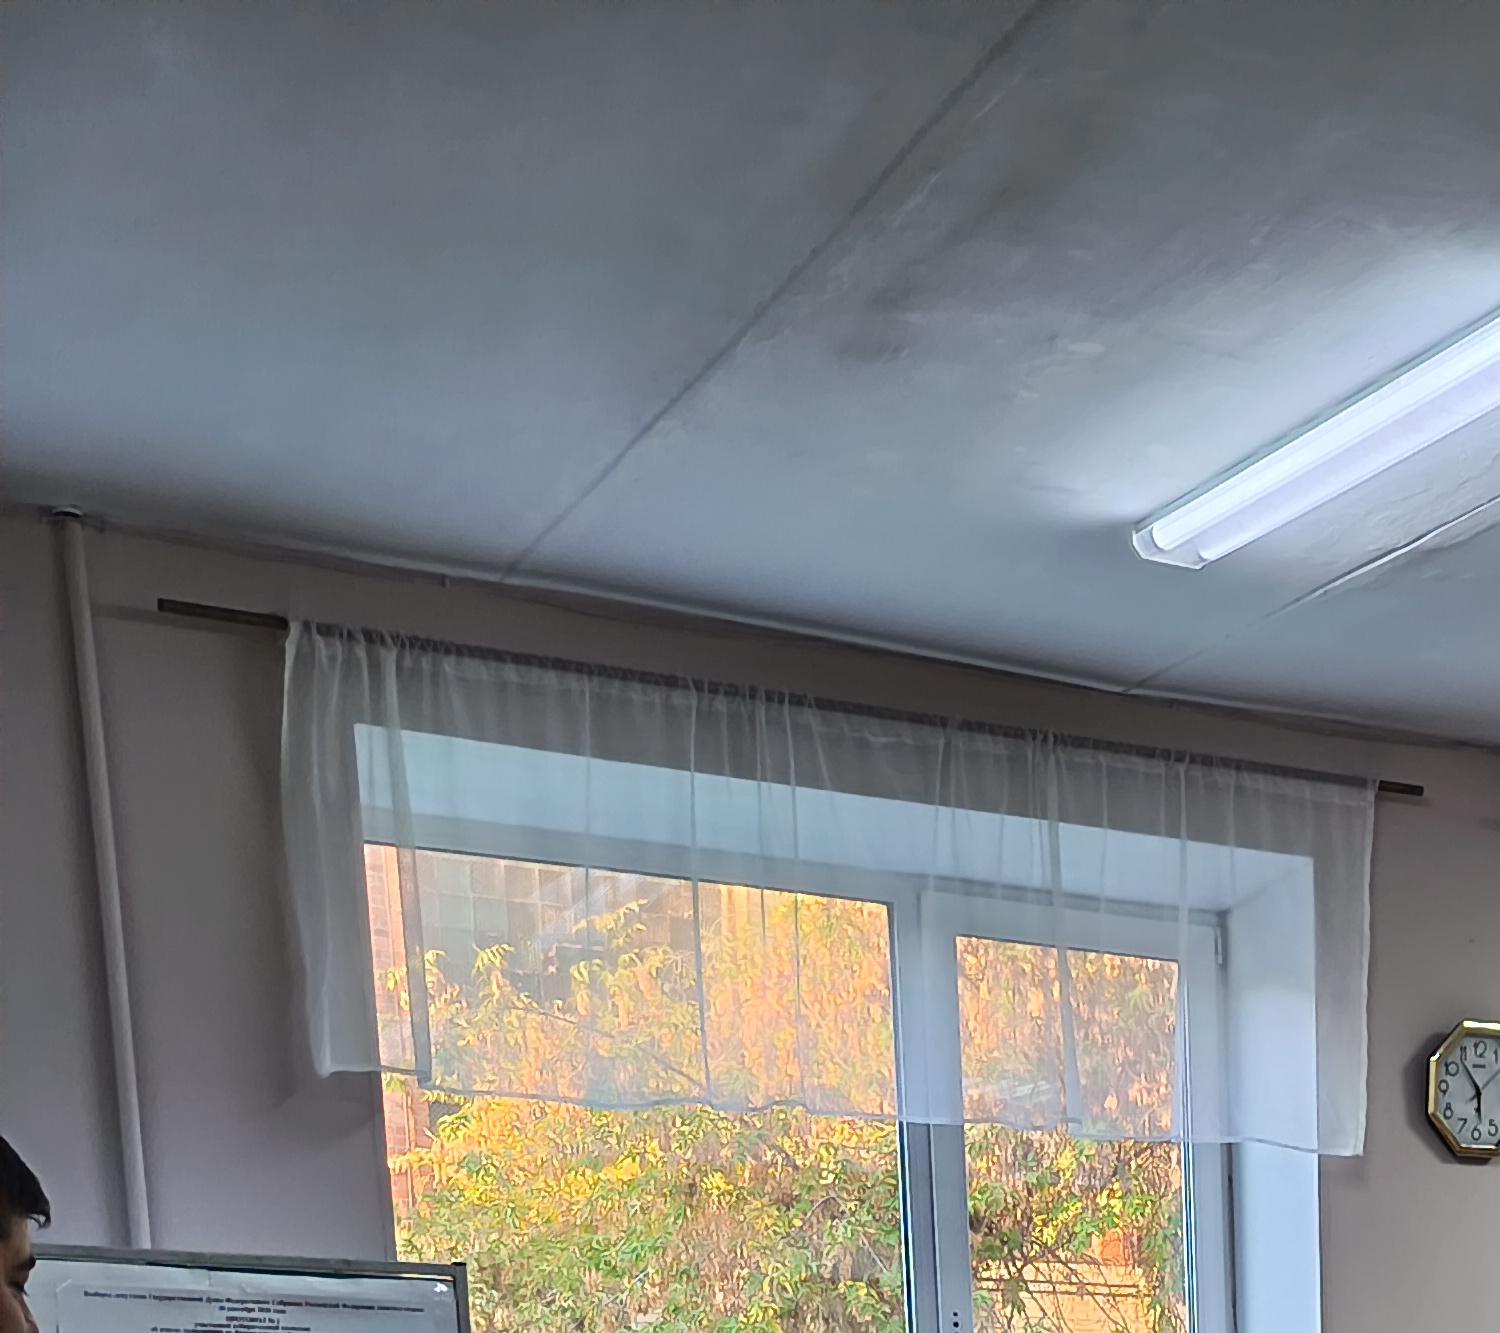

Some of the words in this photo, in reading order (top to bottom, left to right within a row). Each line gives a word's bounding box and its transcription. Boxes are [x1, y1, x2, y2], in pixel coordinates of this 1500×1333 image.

[1460, 1045, 1467, 1061] 11
[1473, 1040, 1487, 1058] 12
[1493, 1047, 1498, 1064] 1
[1444, 1059, 1459, 1077] 10
[1438, 1079, 1449, 1097] 9
[1443, 1102, 1453, 1120] 8
[1457, 1118, 1467, 1134] 7
[1471, 1124, 1481, 1141] 6
[1487, 1119, 1498, 1137] 5
